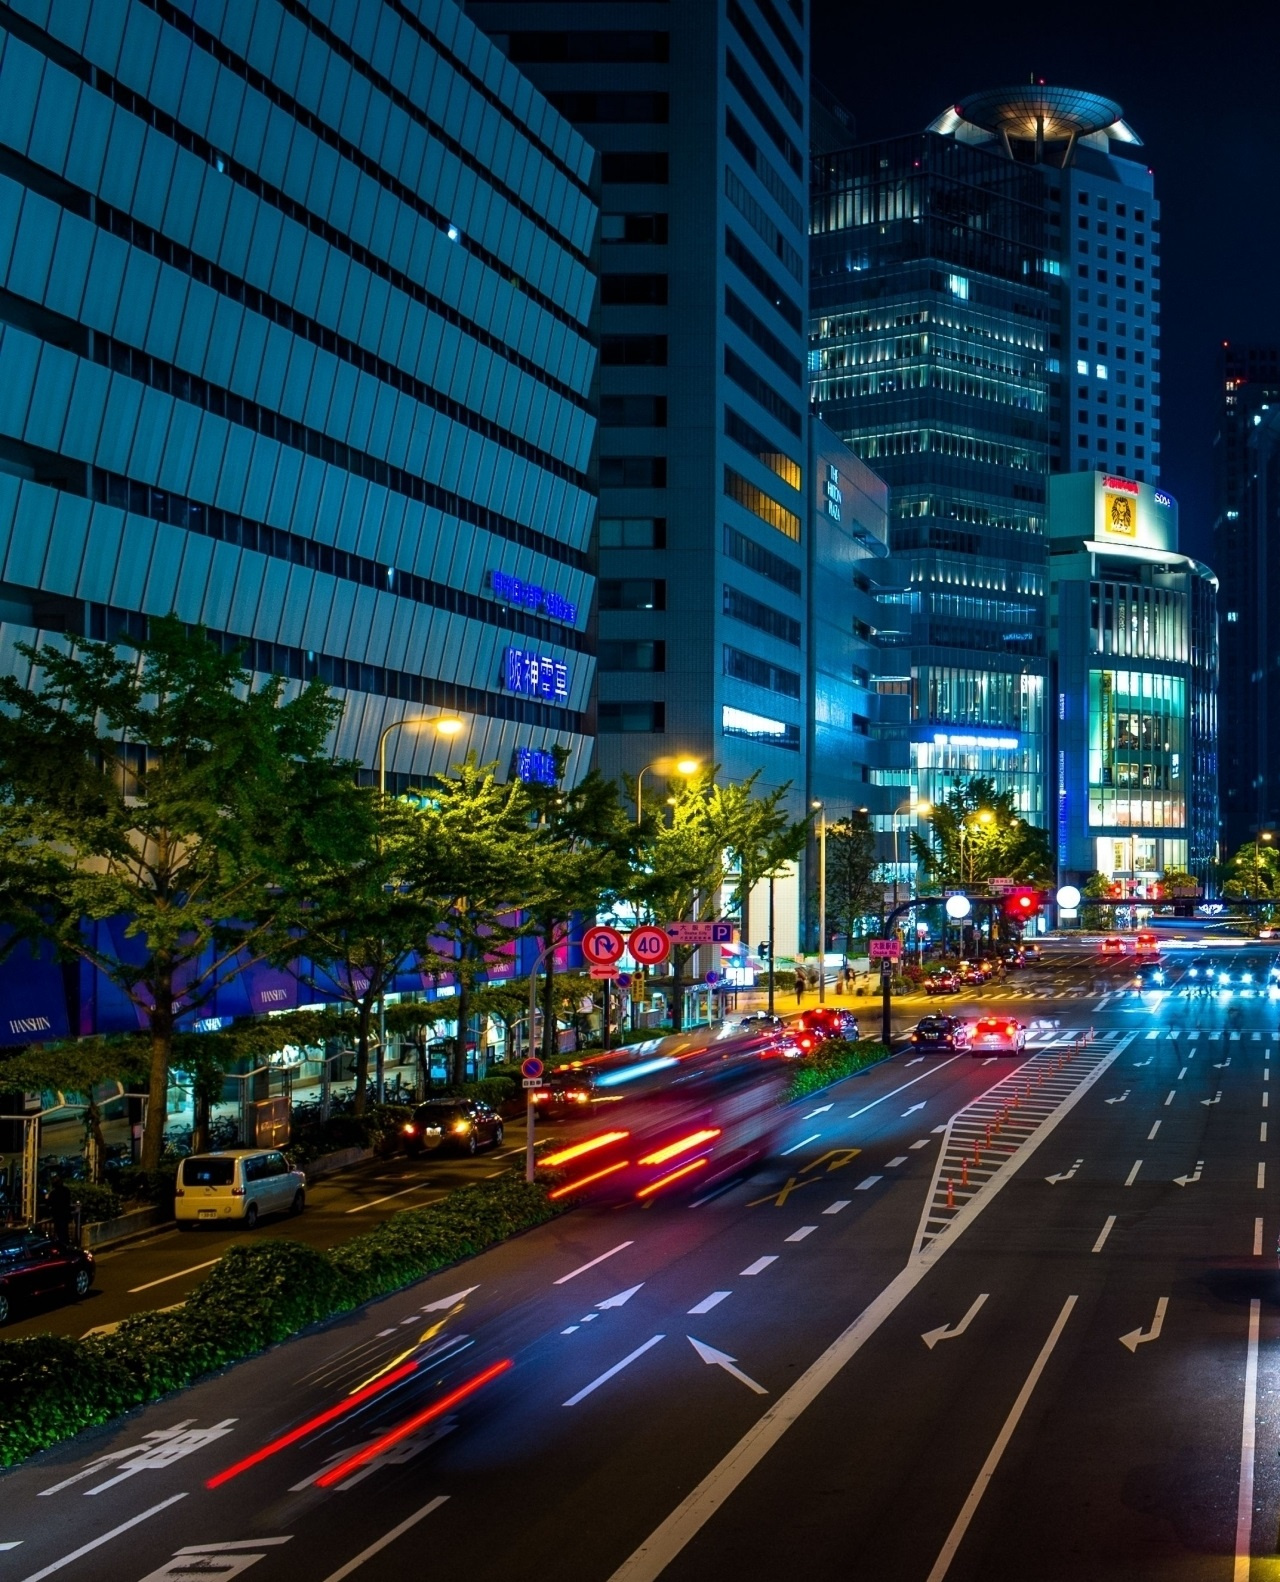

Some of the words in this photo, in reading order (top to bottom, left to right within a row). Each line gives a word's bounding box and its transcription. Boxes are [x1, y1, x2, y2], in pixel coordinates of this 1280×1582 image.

[717, 926, 728, 940] P
[638, 937, 660, 954] 40
[883, 961, 890, 970] P
[10, 1016, 51, 1034] HANSHIN
